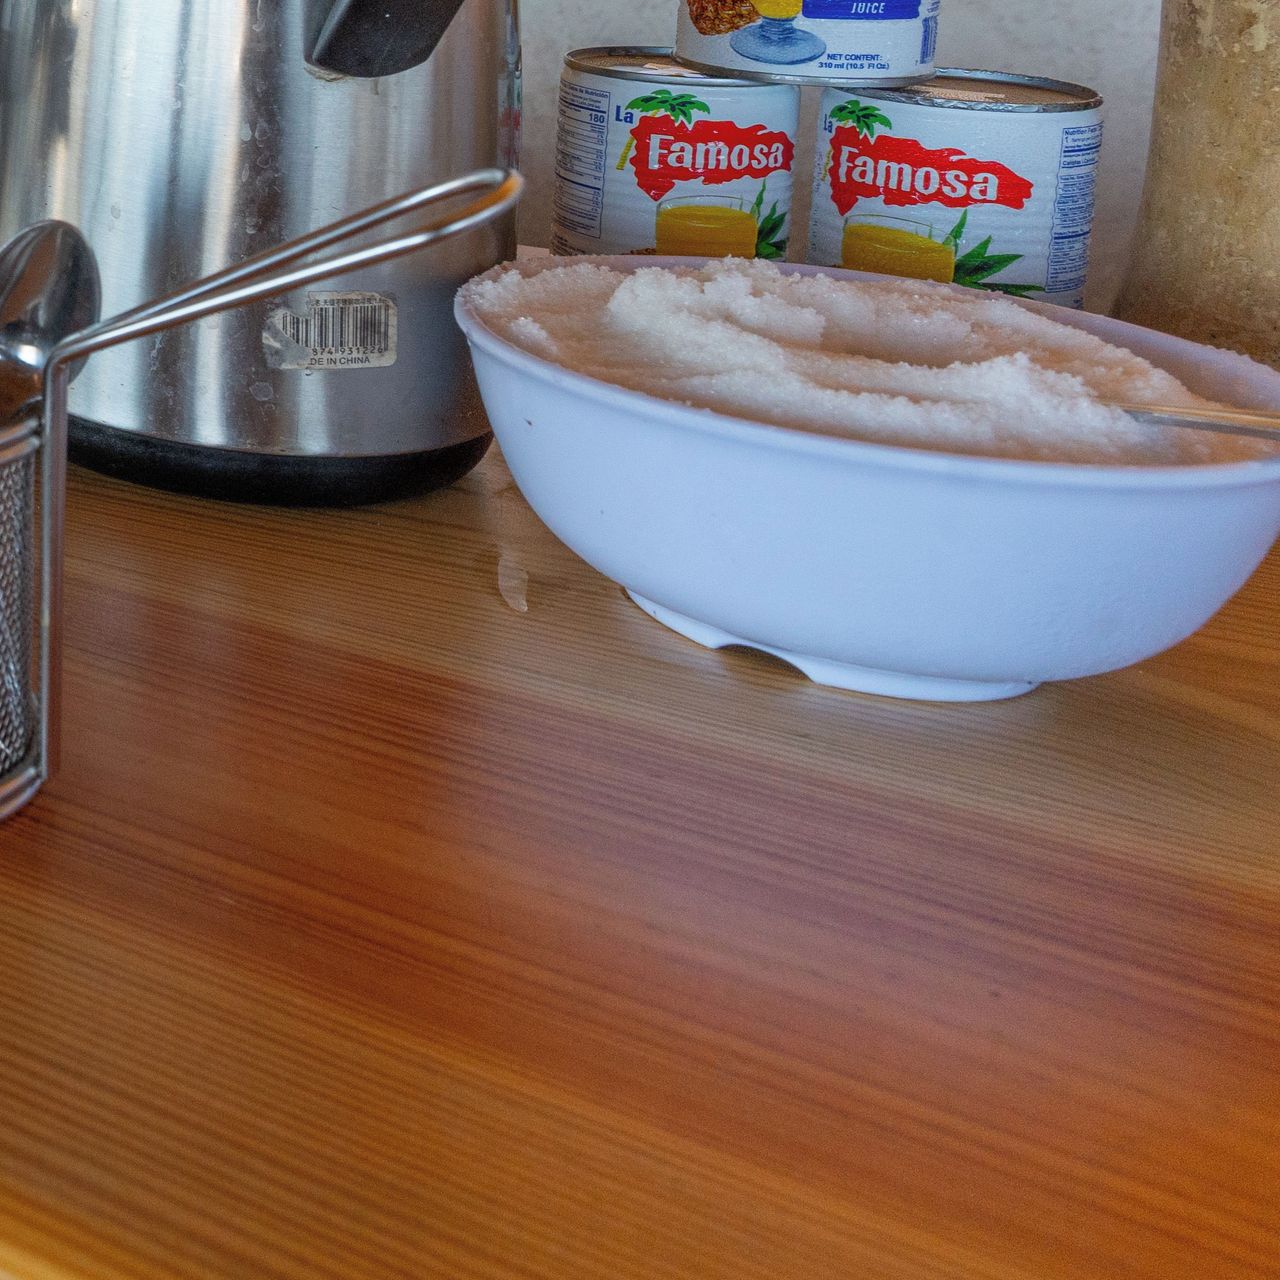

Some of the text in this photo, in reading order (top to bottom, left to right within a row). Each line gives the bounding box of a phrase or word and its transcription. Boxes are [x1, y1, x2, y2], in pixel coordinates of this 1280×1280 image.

[851, 2, 886, 13] JUICE
[827, 53, 842, 61] NET
[818, 61, 833, 69] 310
[845, 62, 865, 70] (10.5
[589, 113, 606, 124] 180
[615, 105, 634, 124] La
[824, 114, 833, 133] La
[648, 134, 784, 170] Famosa
[839, 145, 999, 202] Famosa
[310, 356, 371, 366] DE IN CHINA
